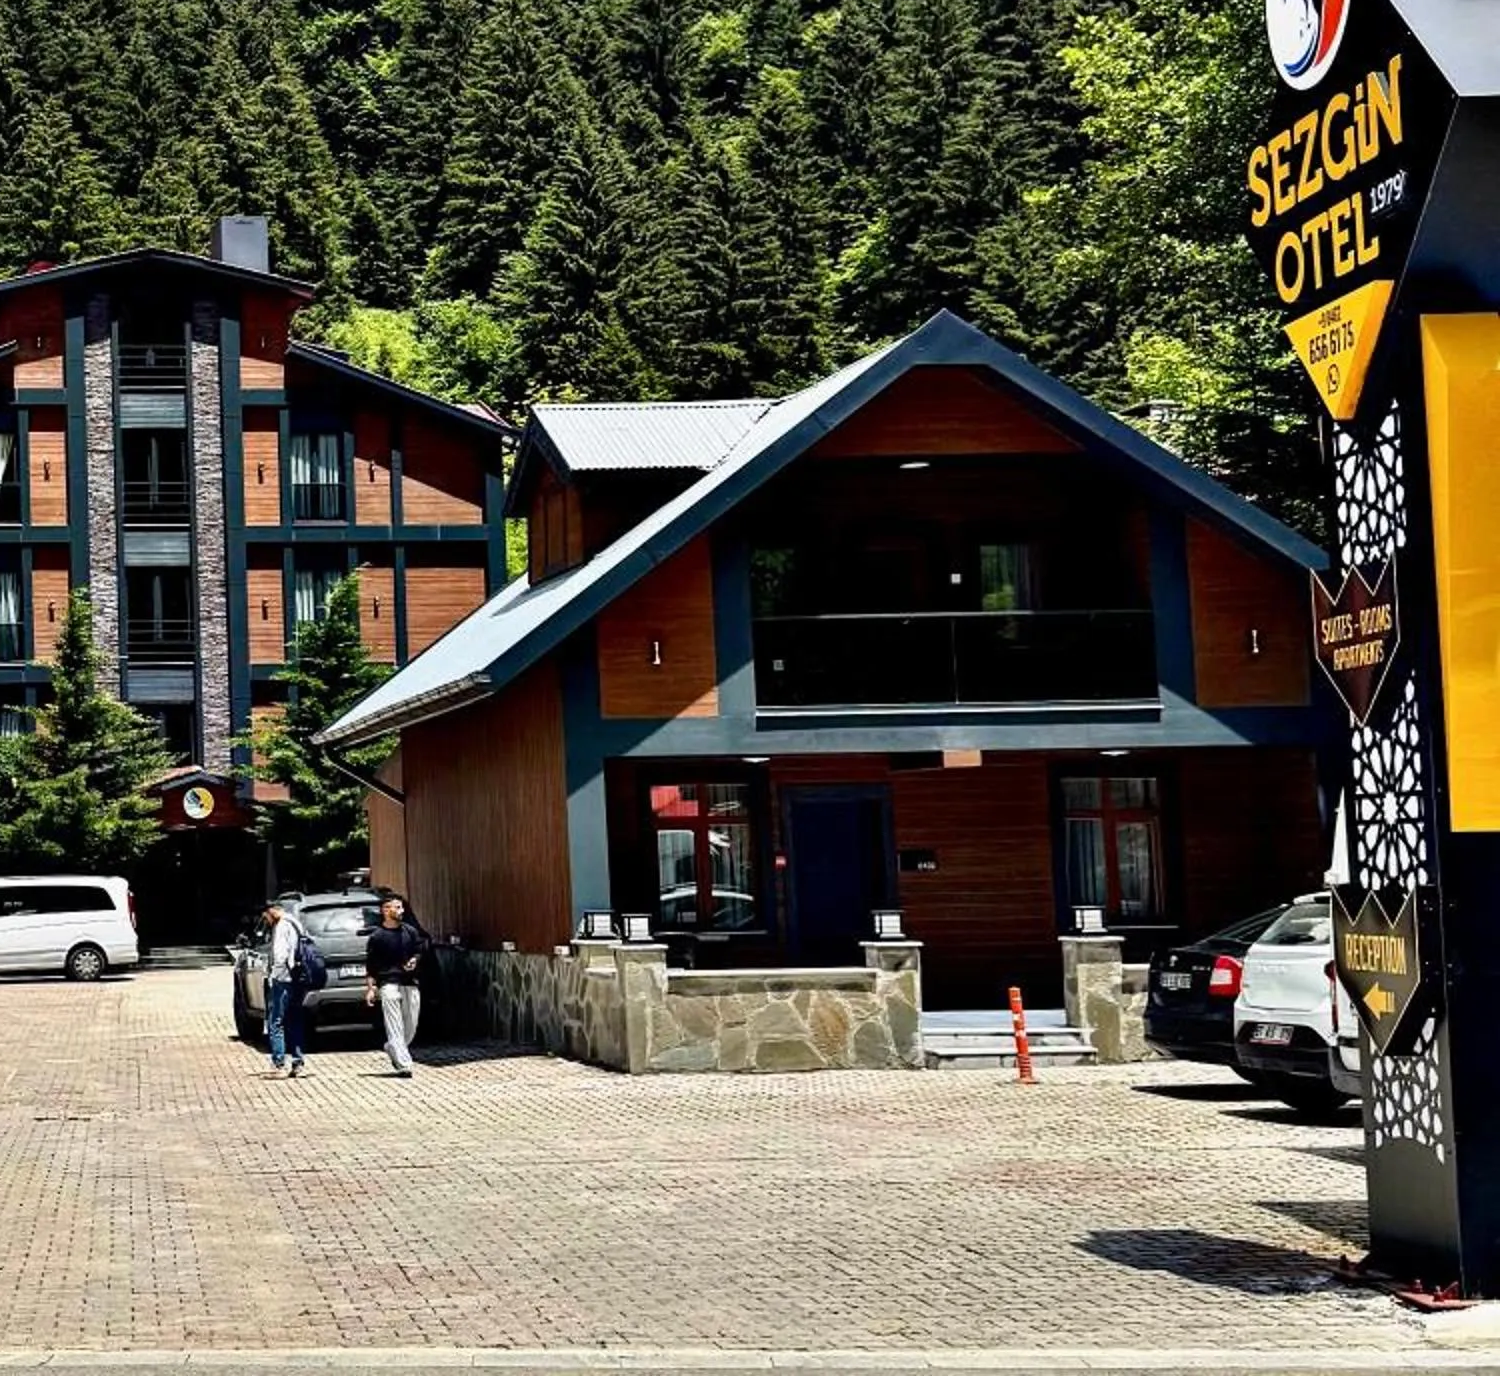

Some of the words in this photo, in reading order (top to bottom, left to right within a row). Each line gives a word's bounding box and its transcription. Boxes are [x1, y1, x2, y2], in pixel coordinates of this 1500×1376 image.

[1275, 192, 1381, 304] OTEL
[1321, 613, 1354, 645] SUITES
[1359, 604, 1393, 636] ROOMS
[1345, 933, 1407, 976] RECEPTION
